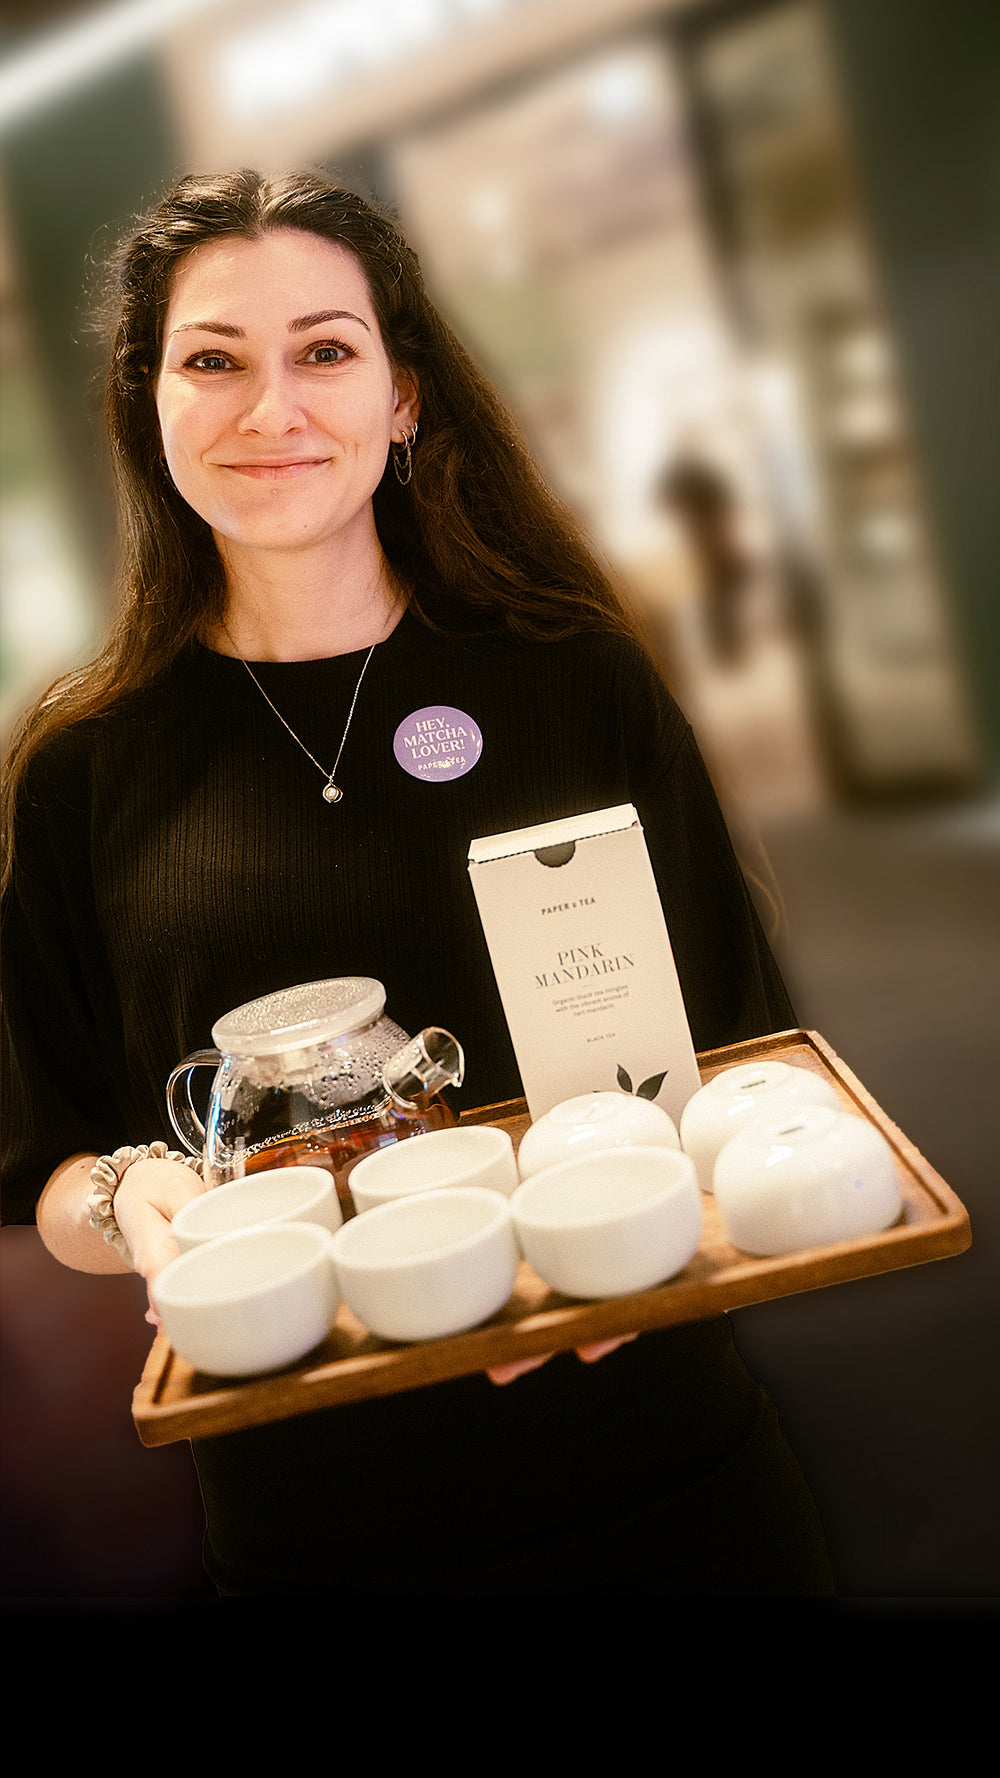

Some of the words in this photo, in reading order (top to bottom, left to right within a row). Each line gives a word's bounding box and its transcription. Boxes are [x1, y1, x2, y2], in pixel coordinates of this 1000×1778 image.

[415, 717, 450, 733] HEY,
[403, 726, 468, 748] MATCHA
[411, 739, 466, 759] LOVER!
[541, 903, 569, 915] PAPER
[579, 897, 596, 906] TEA
[557, 943, 604, 966] PINK
[535, 953, 635, 989] MANDARIN
[552, 996, 575, 1006] Organic
[576, 992, 593, 1000] black
[586, 1035, 604, 1043] BLACK
